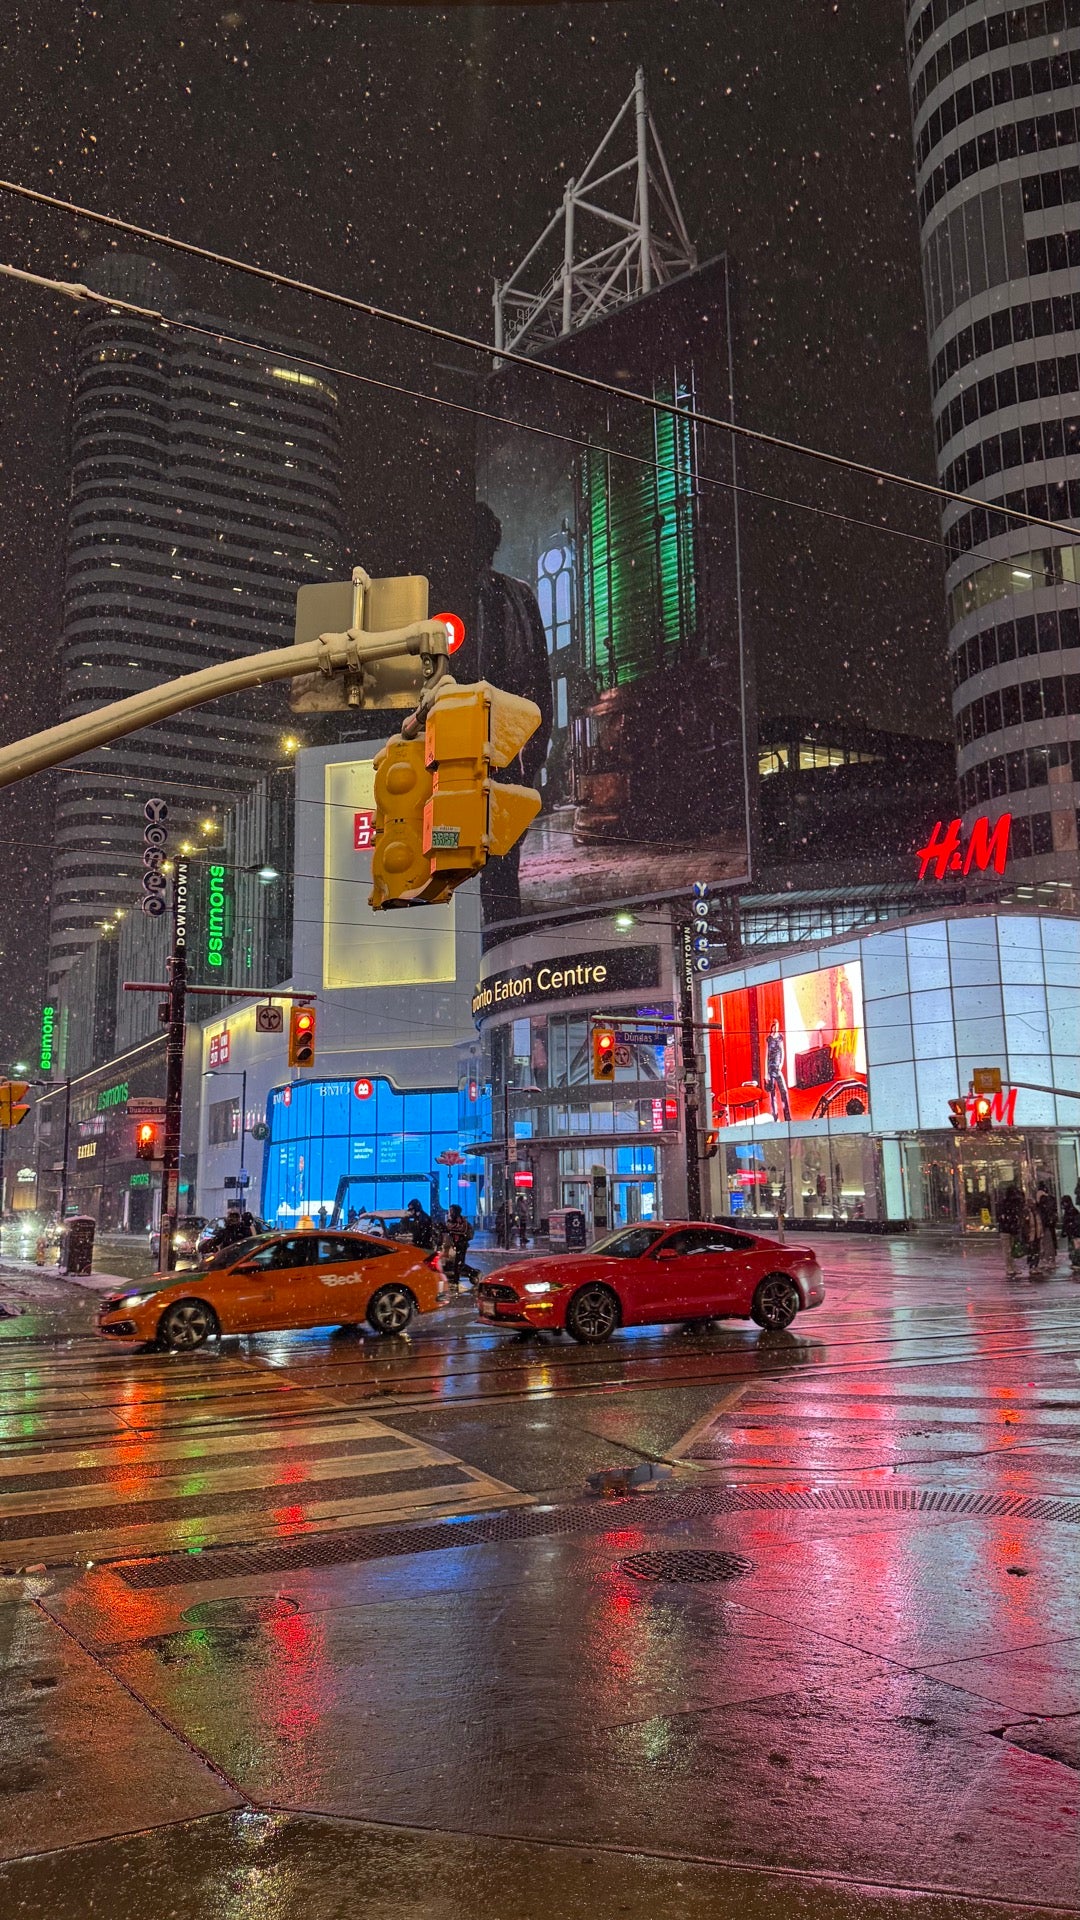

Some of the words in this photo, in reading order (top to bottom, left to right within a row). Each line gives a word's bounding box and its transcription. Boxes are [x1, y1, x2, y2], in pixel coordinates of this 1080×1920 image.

[916, 813, 1012, 880] H&M
[176, 863, 189, 947] DOWNTOWN
[693, 880, 711, 973] Yonge
[494, 976, 532, 1002] Eaton
[536, 964, 608, 991] Centre
[683, 926, 693, 993] DOWNTOWN
[624, 1032, 653, 1043] Dundas
[319, 1085, 350, 1096] BMO
